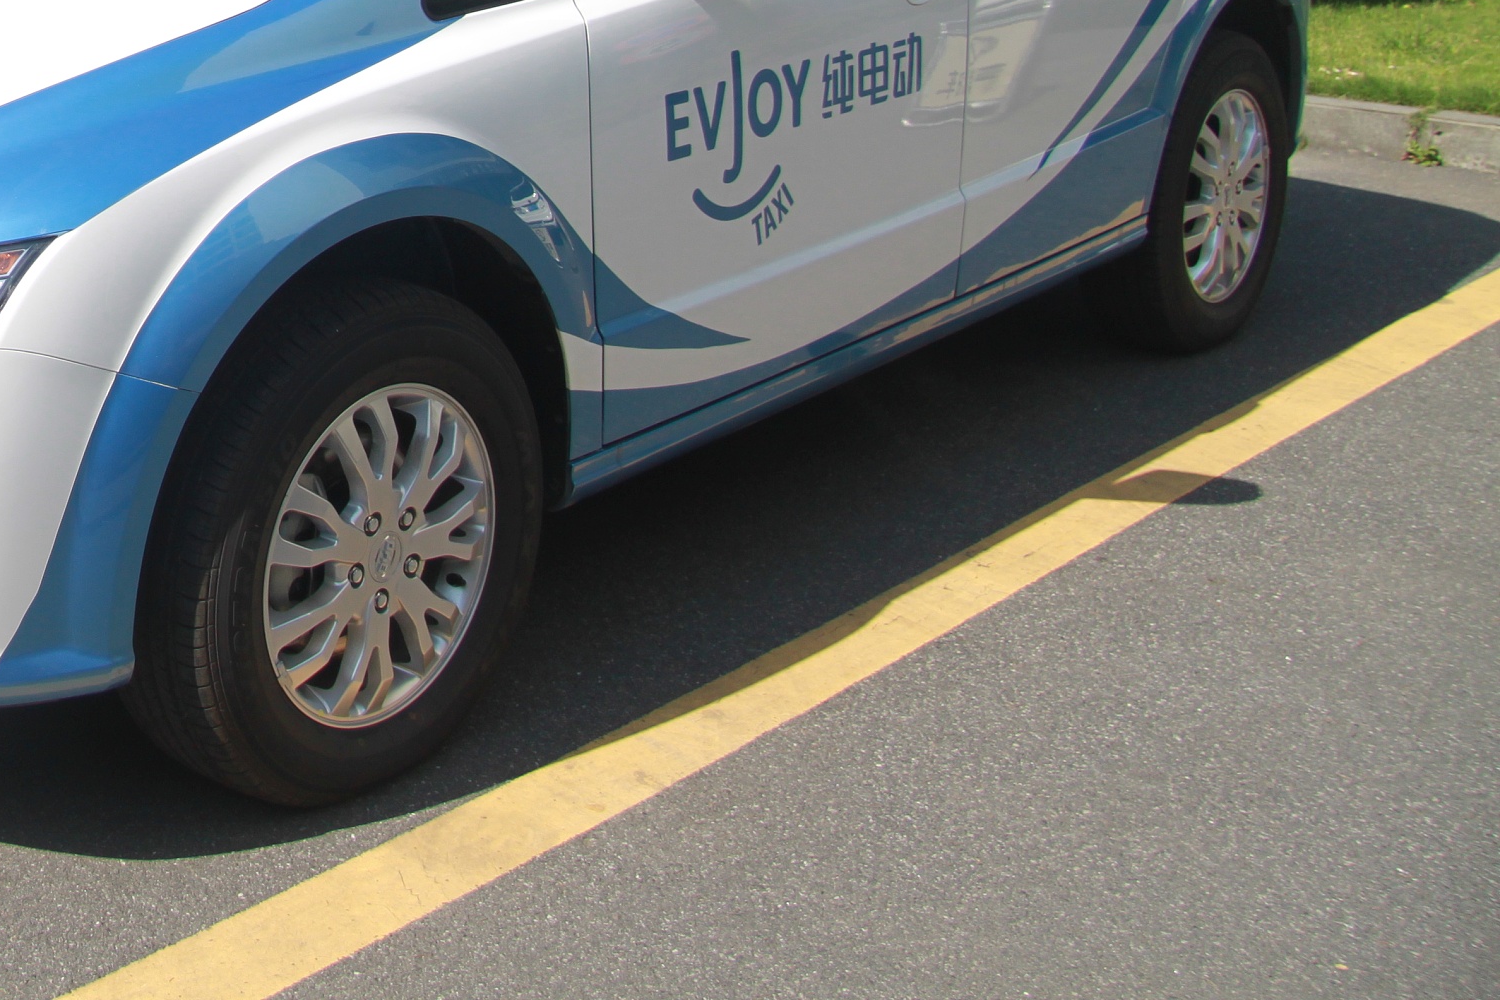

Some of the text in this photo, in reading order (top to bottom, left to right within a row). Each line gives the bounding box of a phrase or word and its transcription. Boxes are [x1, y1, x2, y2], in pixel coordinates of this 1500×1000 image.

[664, 32, 922, 184] EVJOY 纯电动
[751, 182, 795, 246] TAXI
